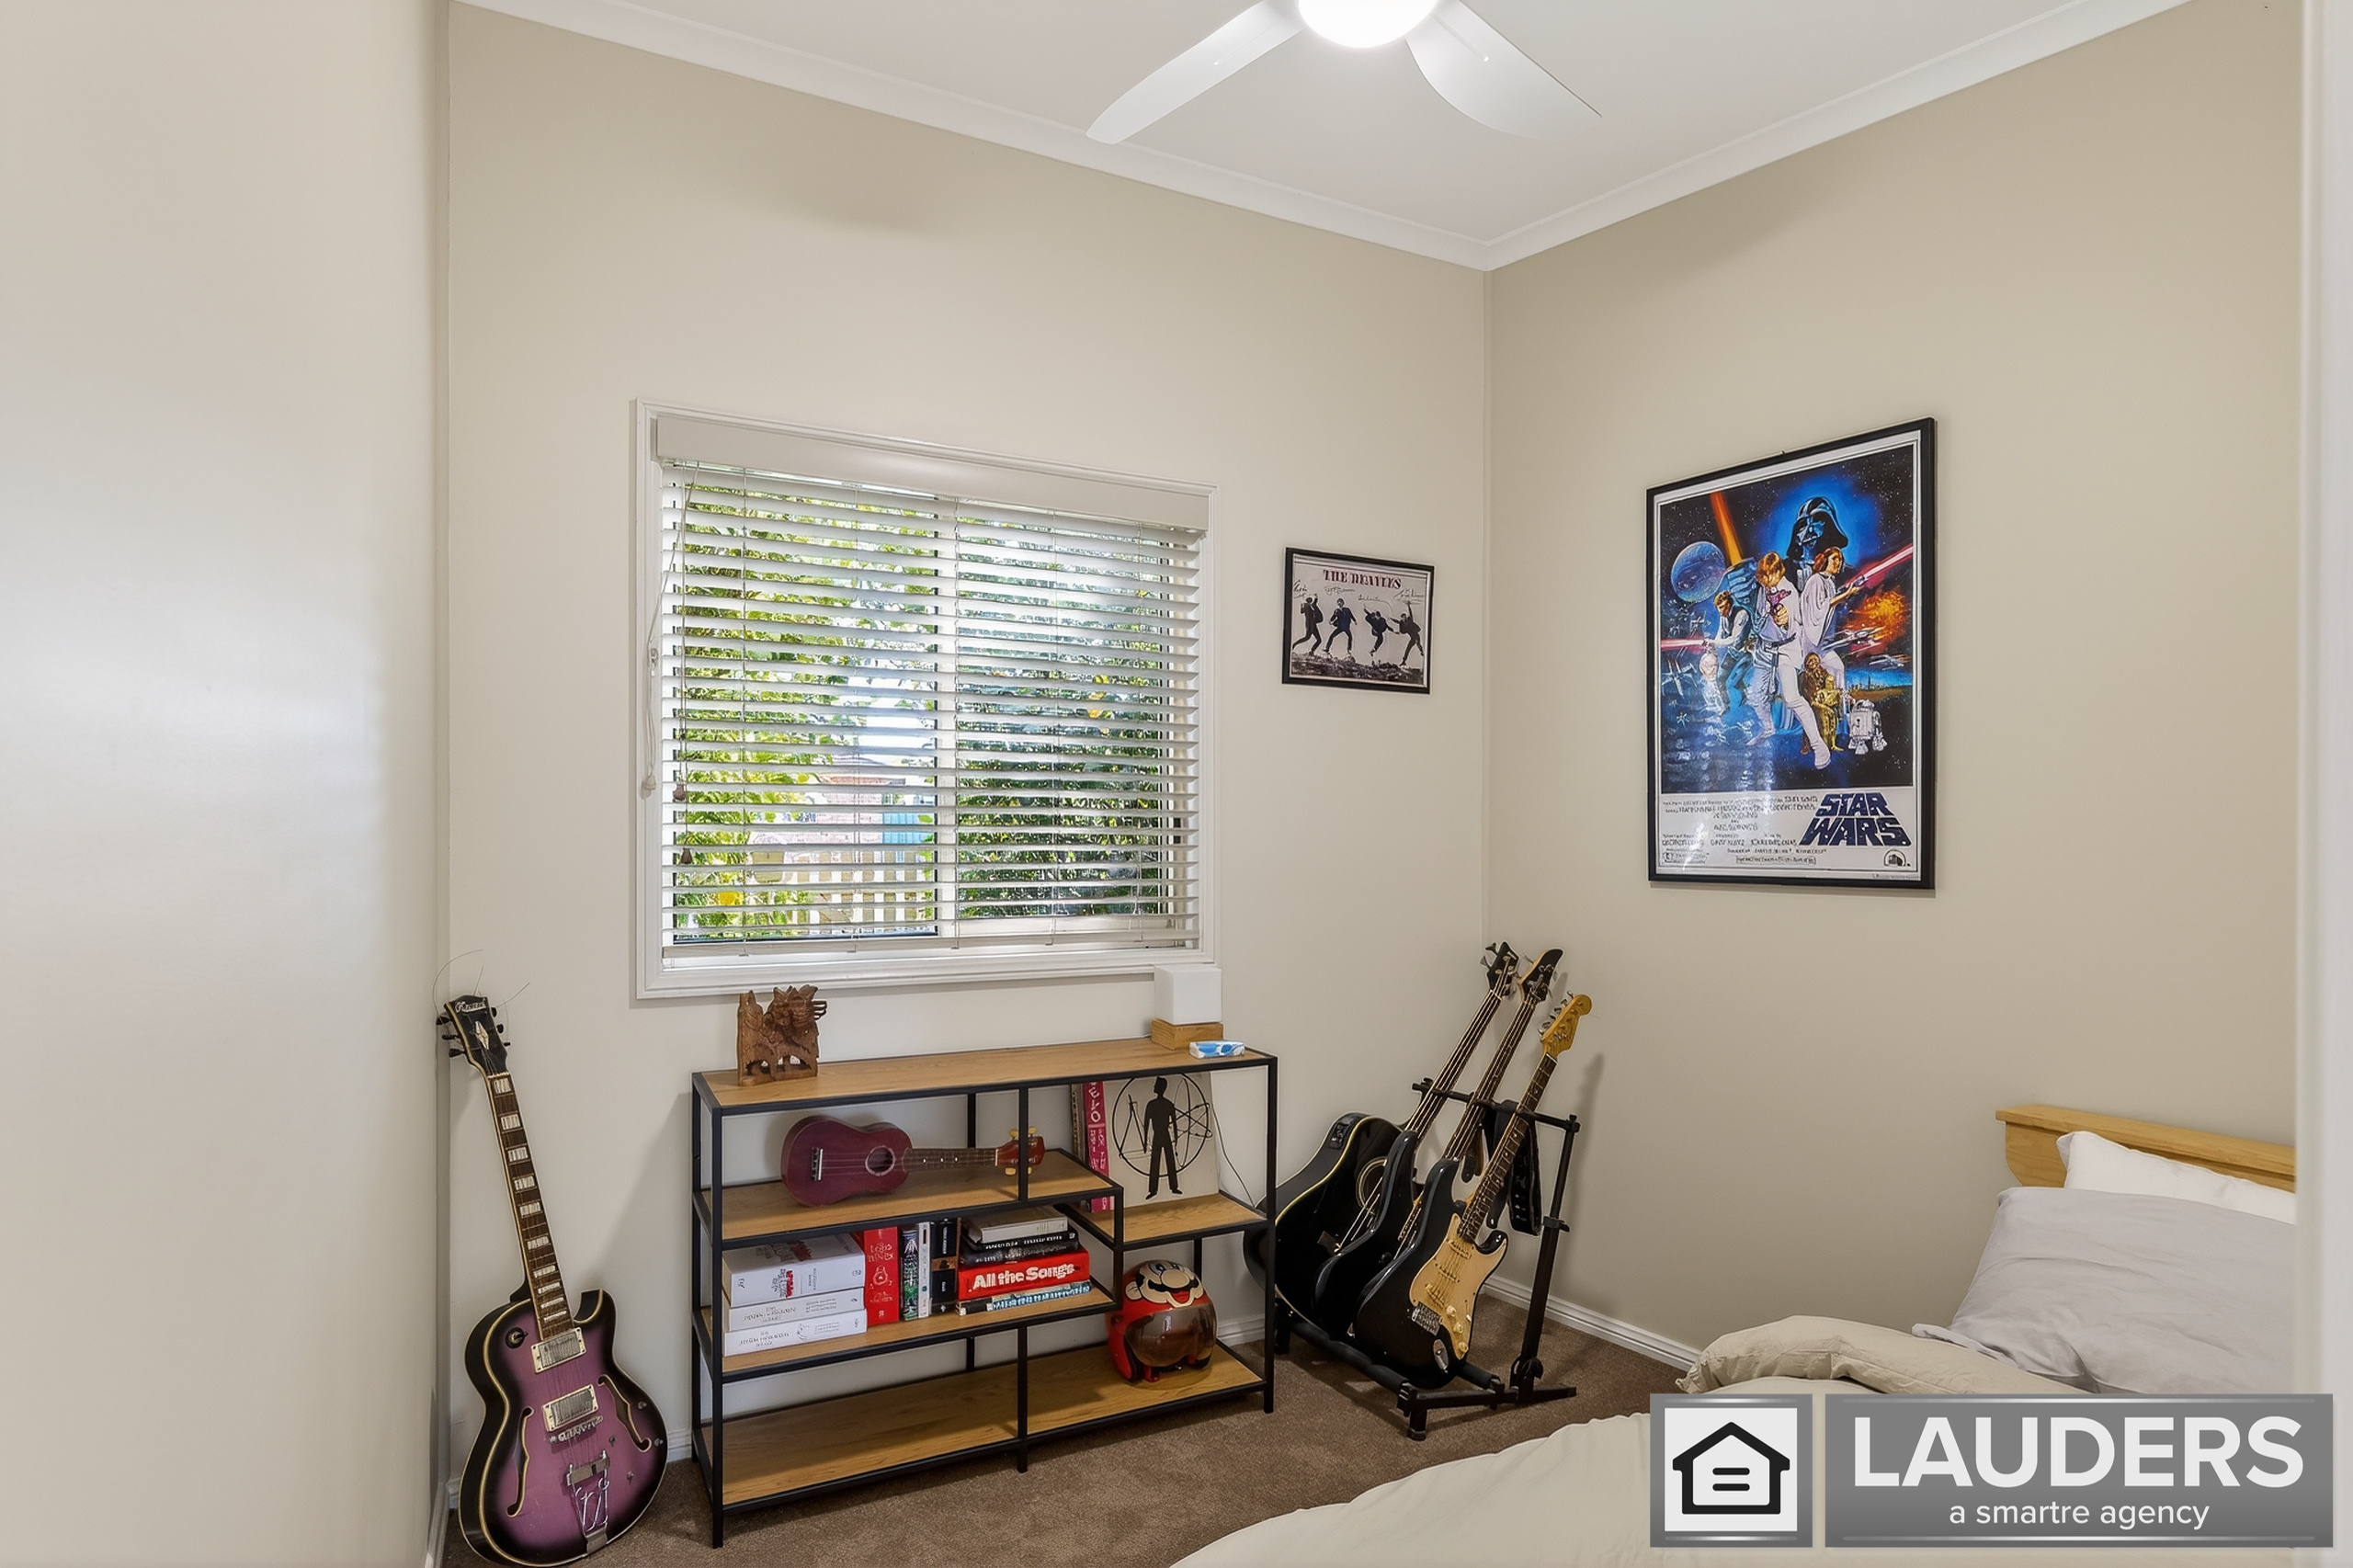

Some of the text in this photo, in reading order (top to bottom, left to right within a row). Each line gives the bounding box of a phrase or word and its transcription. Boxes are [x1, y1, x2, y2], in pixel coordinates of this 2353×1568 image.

[1324, 570, 1402, 589] THE BEATLES
[1815, 792, 1895, 817] STAR
[1799, 816, 1913, 846] WARS
[972, 1263, 1075, 1290] All the Songs
